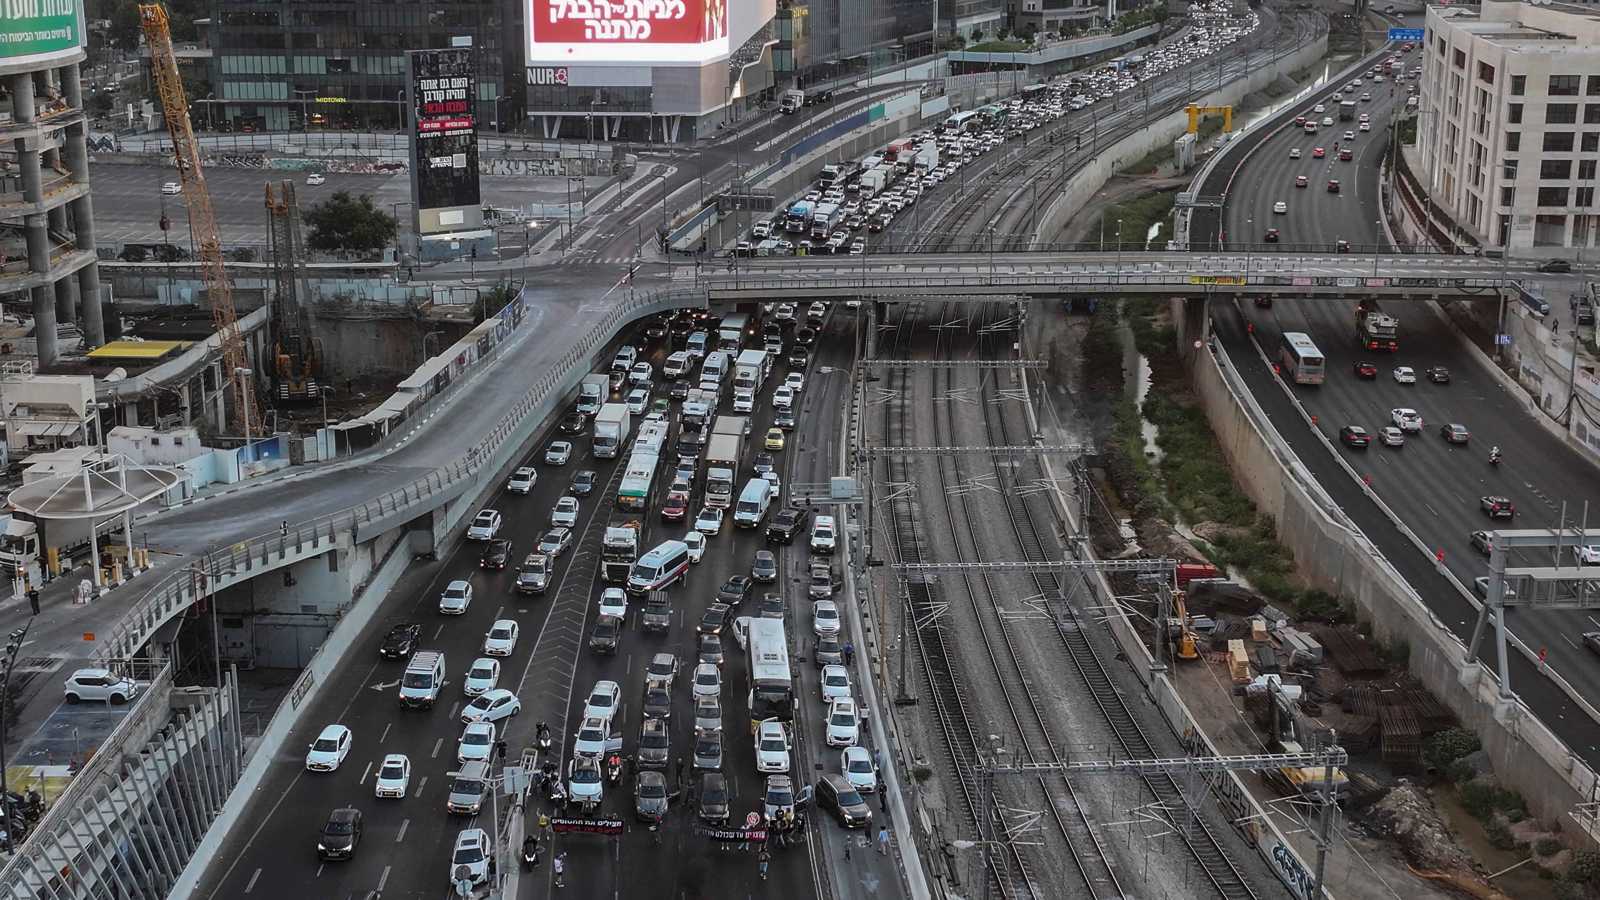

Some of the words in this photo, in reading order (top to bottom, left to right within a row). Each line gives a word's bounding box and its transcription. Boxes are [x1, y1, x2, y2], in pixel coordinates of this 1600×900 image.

[549, 0, 612, 23] הבנק
[627, 0, 686, 19] מניות
[584, 19, 651, 40] מתנה
[420, 79, 438, 90] אתה
[440, 79, 450, 89] גם
[451, 77, 468, 89] האם
[424, 90, 445, 104] קורבן
[446, 89, 466, 100] תהיה
